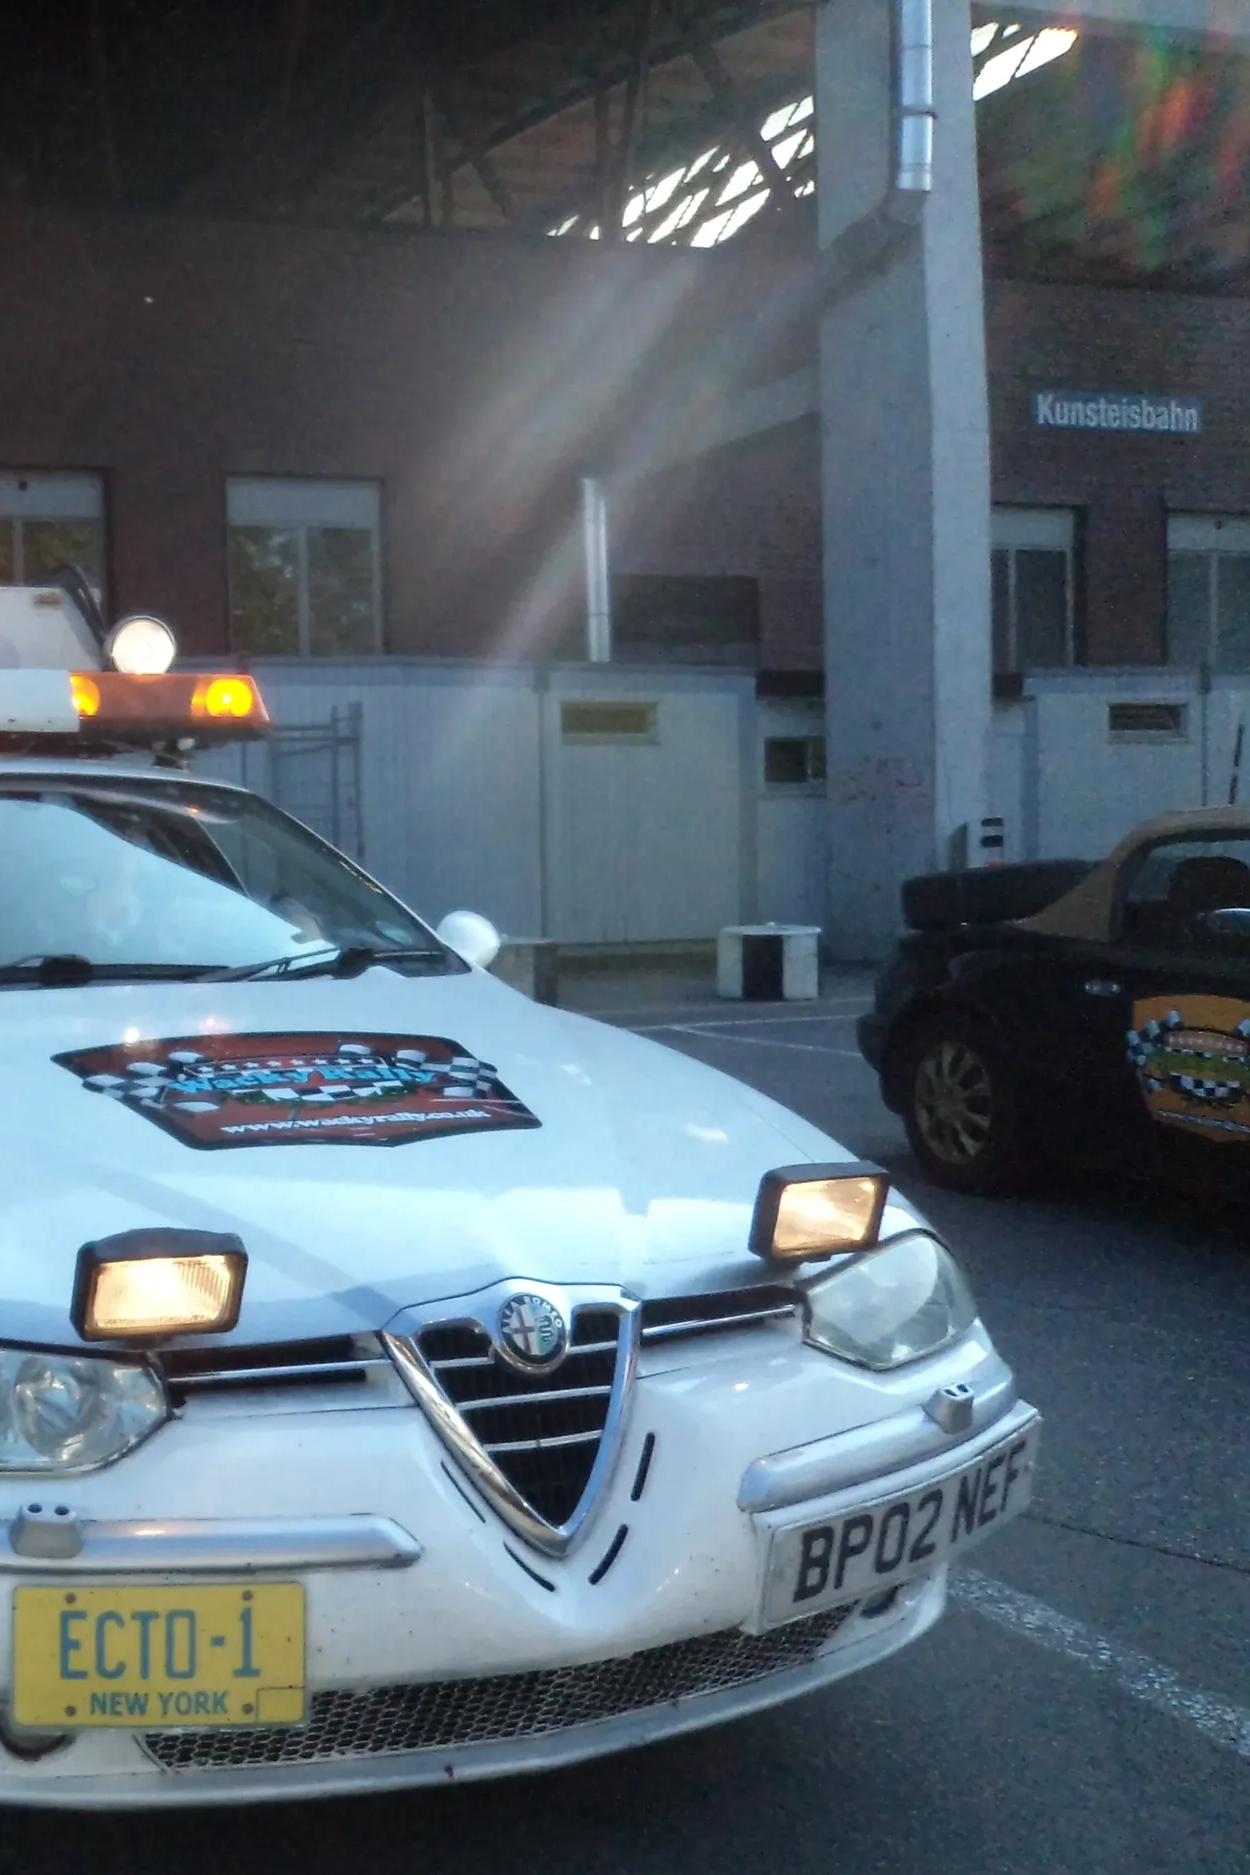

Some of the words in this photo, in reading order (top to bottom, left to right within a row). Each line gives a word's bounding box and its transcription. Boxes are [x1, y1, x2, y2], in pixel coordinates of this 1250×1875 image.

[1036, 393, 1199, 432] Kunsteisbahn
[220, 1108, 493, 1135] www.wackyrally.co.uk
[502, 1300, 521, 1335] ALFA
[523, 1295, 563, 1329] ROMEO
[793, 1488, 944, 1603] BP02
[950, 1440, 1027, 1544] NEF
[59, 1607, 261, 1680] ECTO-1
[90, 1692, 149, 1716] NEW
[159, 1691, 229, 1715] YORK
